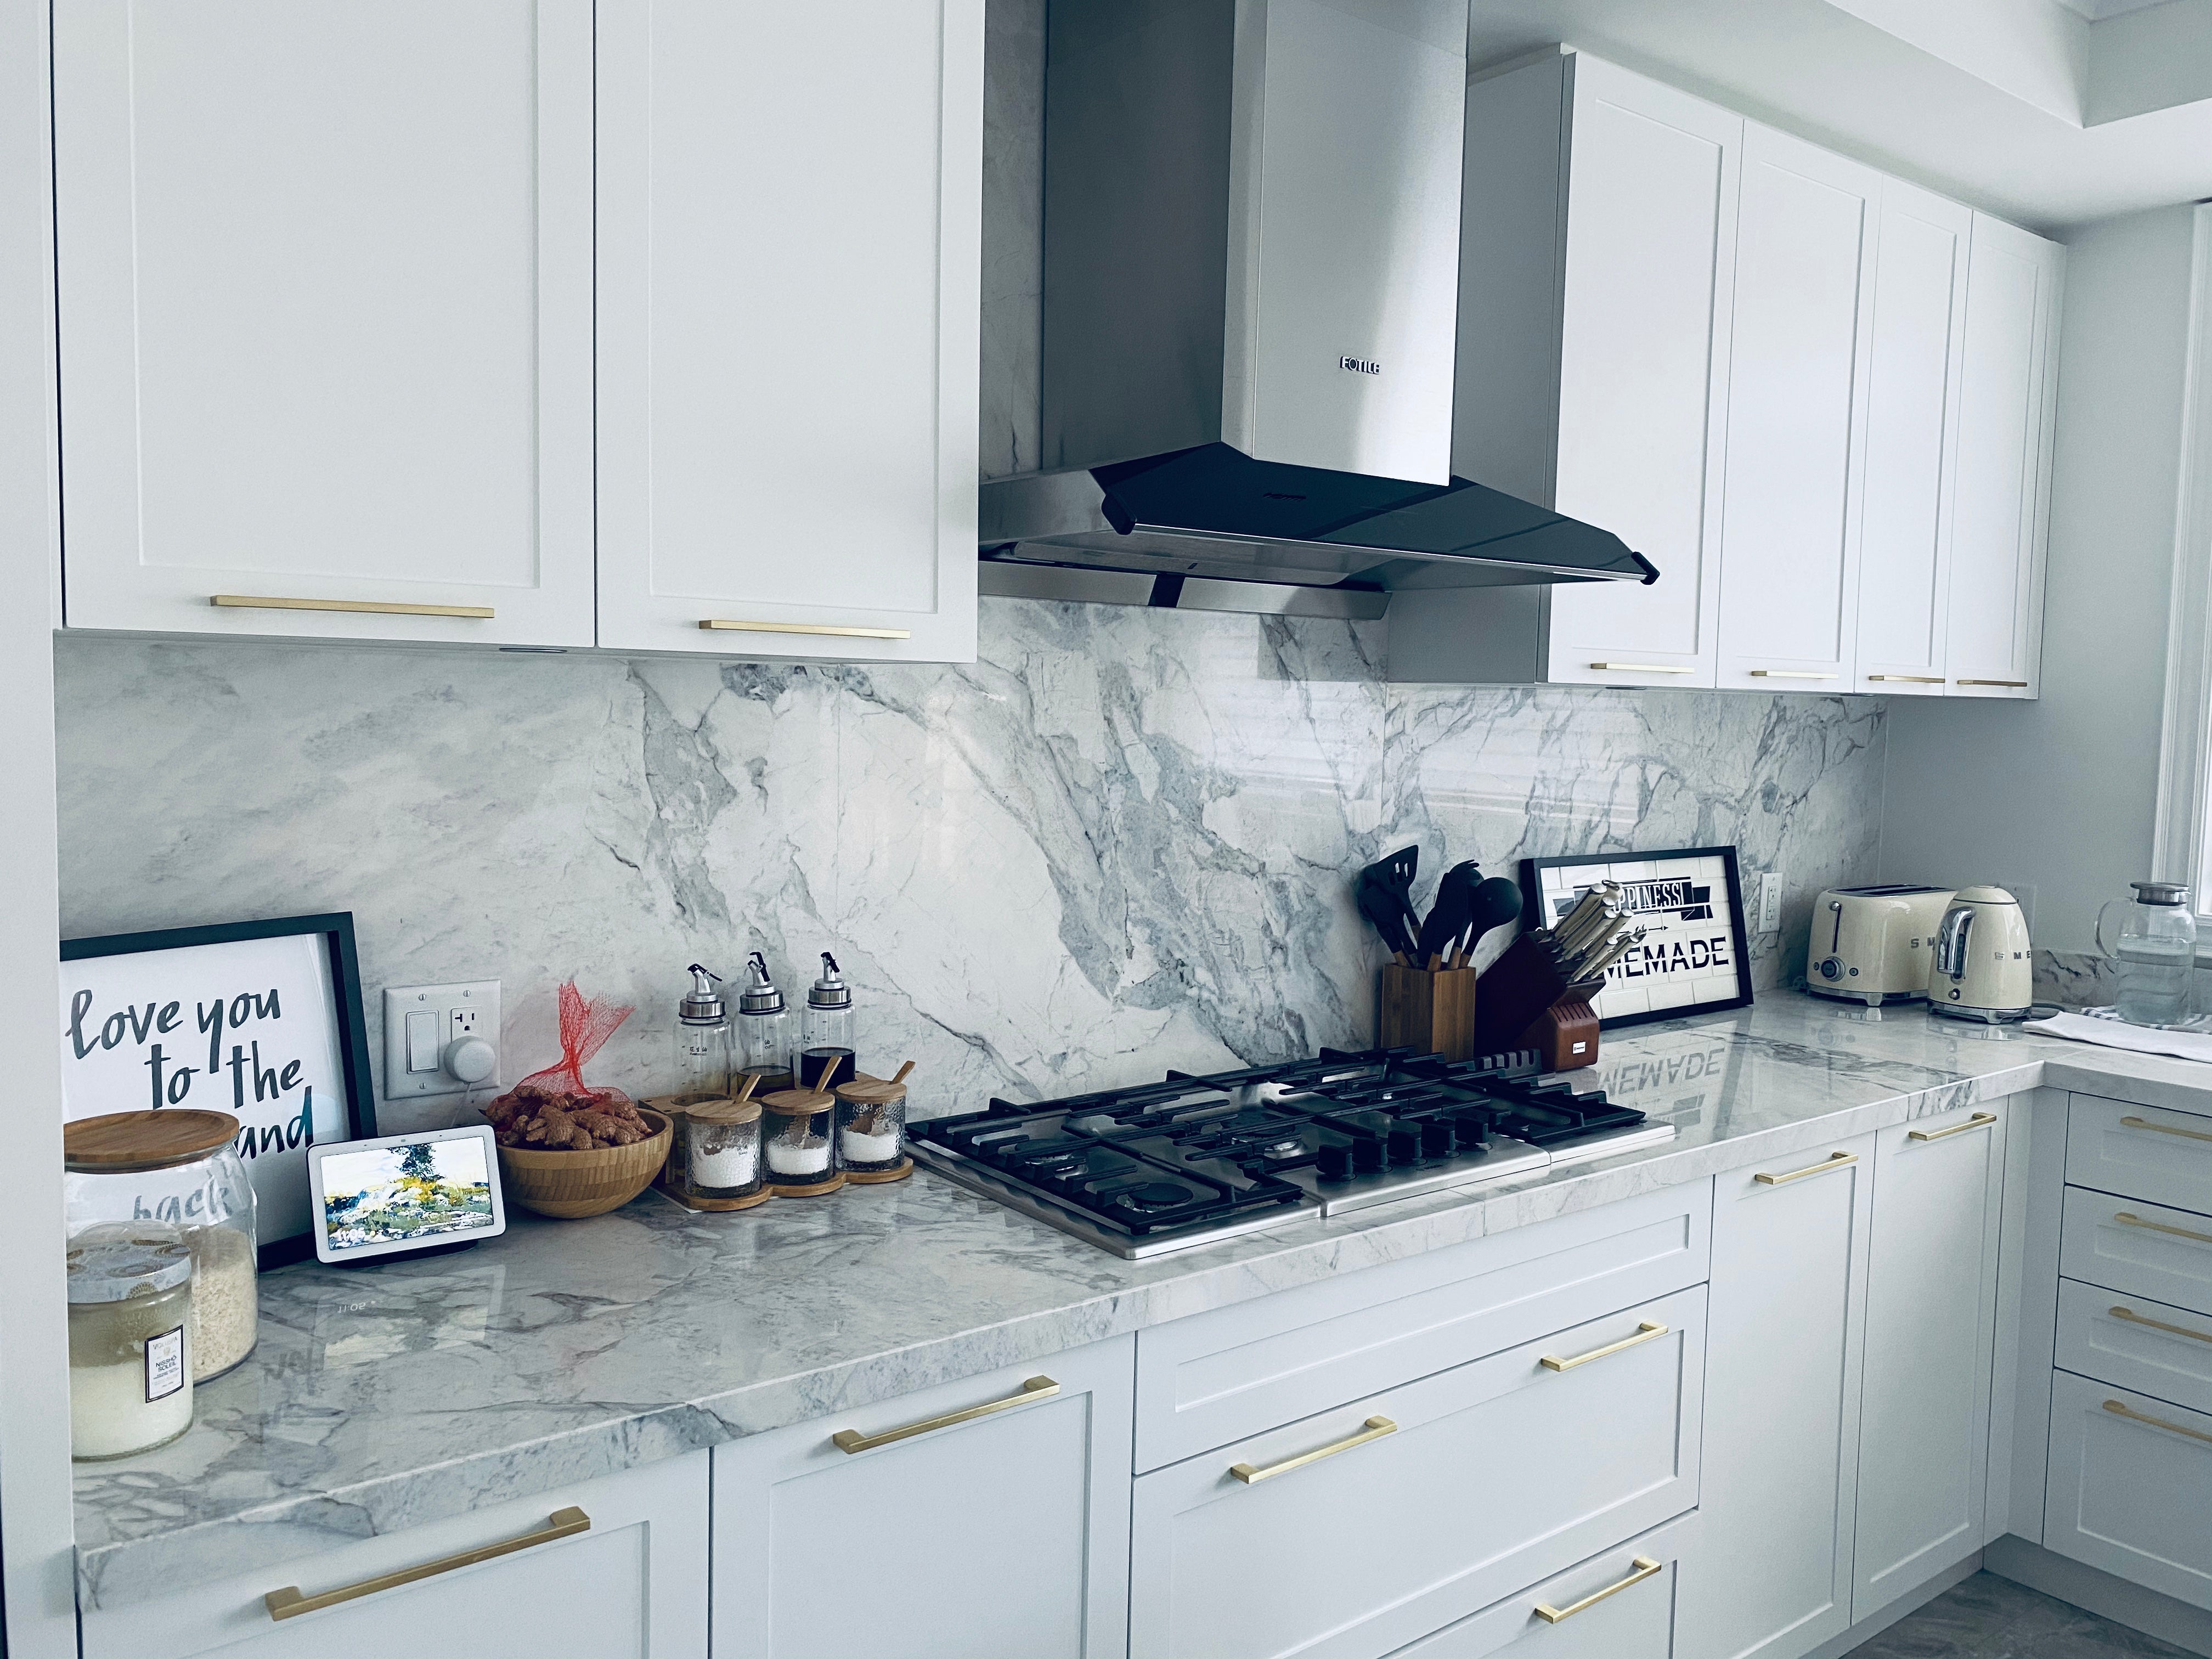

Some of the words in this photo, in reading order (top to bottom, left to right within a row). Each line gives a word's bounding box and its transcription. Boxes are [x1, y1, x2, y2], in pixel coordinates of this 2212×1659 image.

[1340, 356, 1380, 375] FOTILE
[65, 989, 183, 1060] love
[197, 989, 281, 1074] you
[144, 1043, 201, 1110] to
[226, 1040, 304, 1109] the
[234, 1085, 314, 1160] and
[337, 1227, 366, 1242] 11:05
